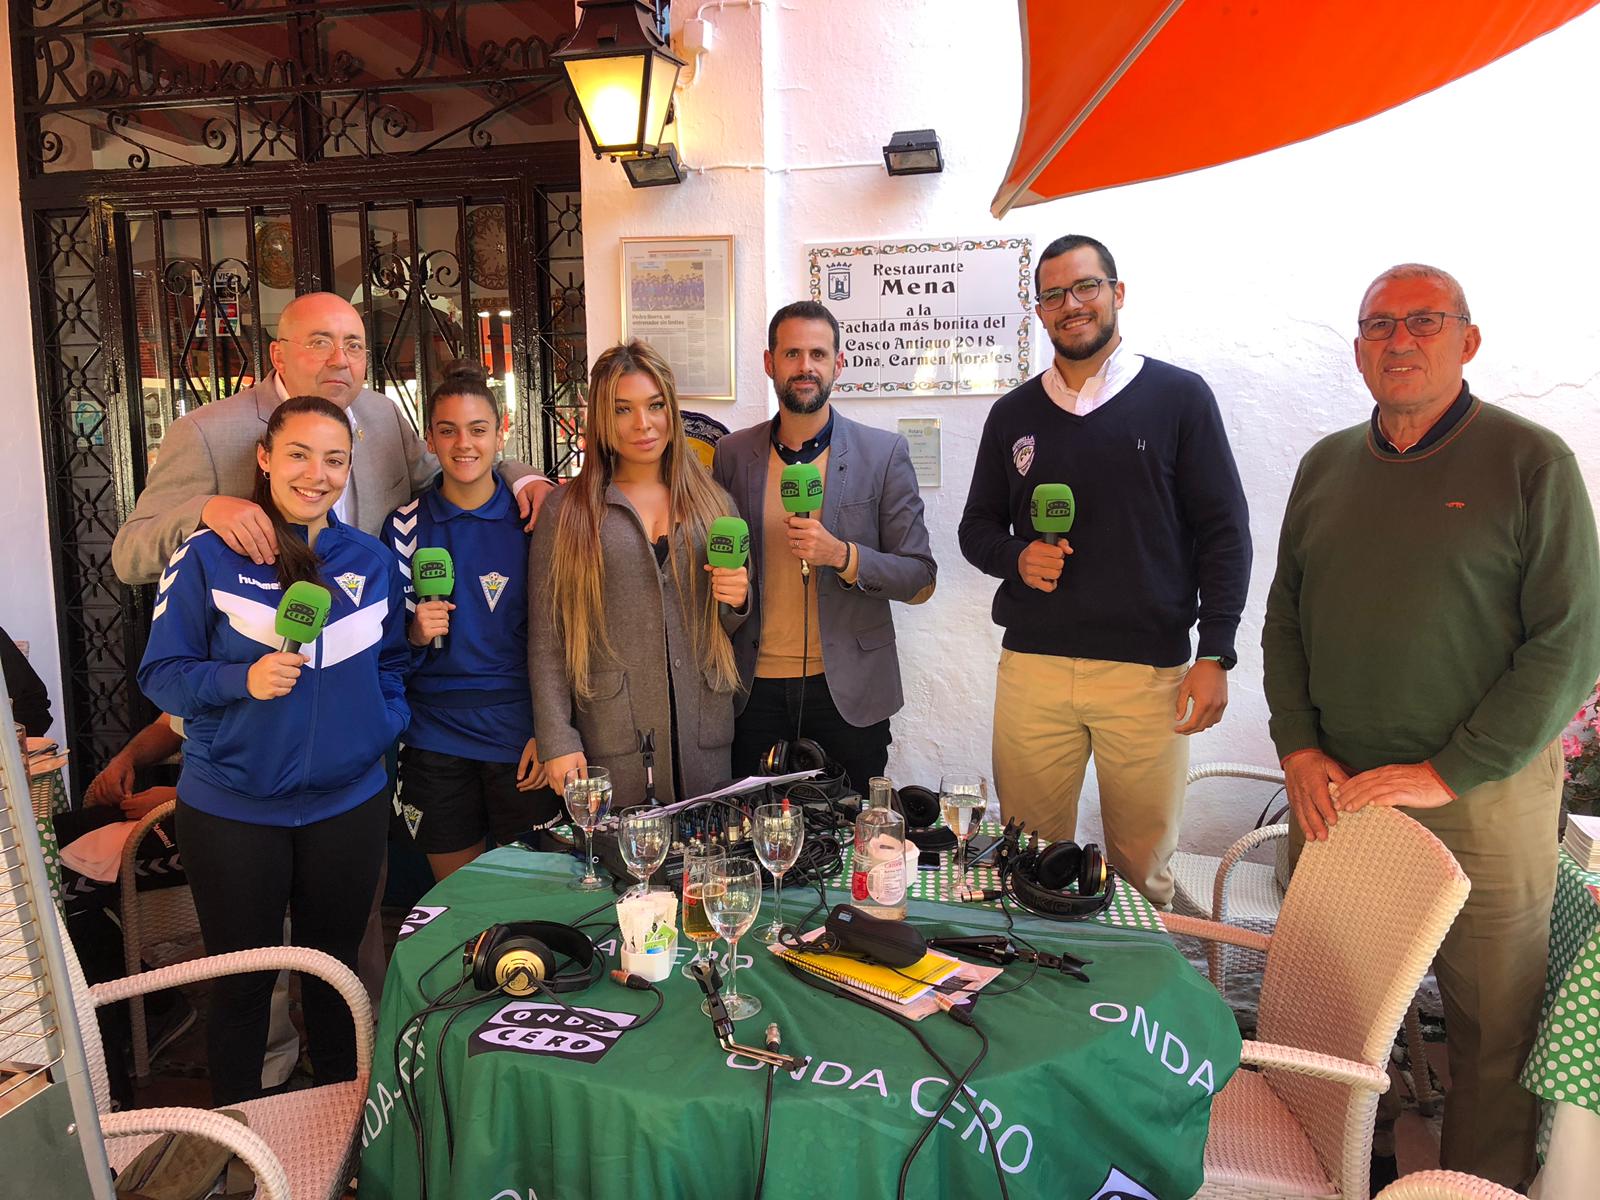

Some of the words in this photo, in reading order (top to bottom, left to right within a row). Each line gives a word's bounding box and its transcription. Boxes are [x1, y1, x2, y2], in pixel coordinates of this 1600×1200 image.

[37, 10, 355, 103] Restaurante
[873, 262, 964, 276] Restaurante
[881, 279, 956, 296] Mena
[906, 306, 914, 316] a
[919, 304, 931, 316] la
[900, 318, 930, 332] más
[933, 317, 979, 330] bonita
[983, 316, 1006, 329] del
[845, 339, 890, 351] Casco
[895, 336, 950, 350] Antiguo
[956, 335, 995, 348] 2018
[889, 354, 946, 366] Carmen
[951, 351, 1012, 364] Morales
[1137, 438, 1146, 451] H
[513, 1010, 604, 1030] ONDA
[497, 1029, 591, 1050] CERO
[1089, 1002, 1215, 1096] ONDA
[725, 1051, 888, 1097] ONDA
[910, 1076, 1034, 1174] CERO
